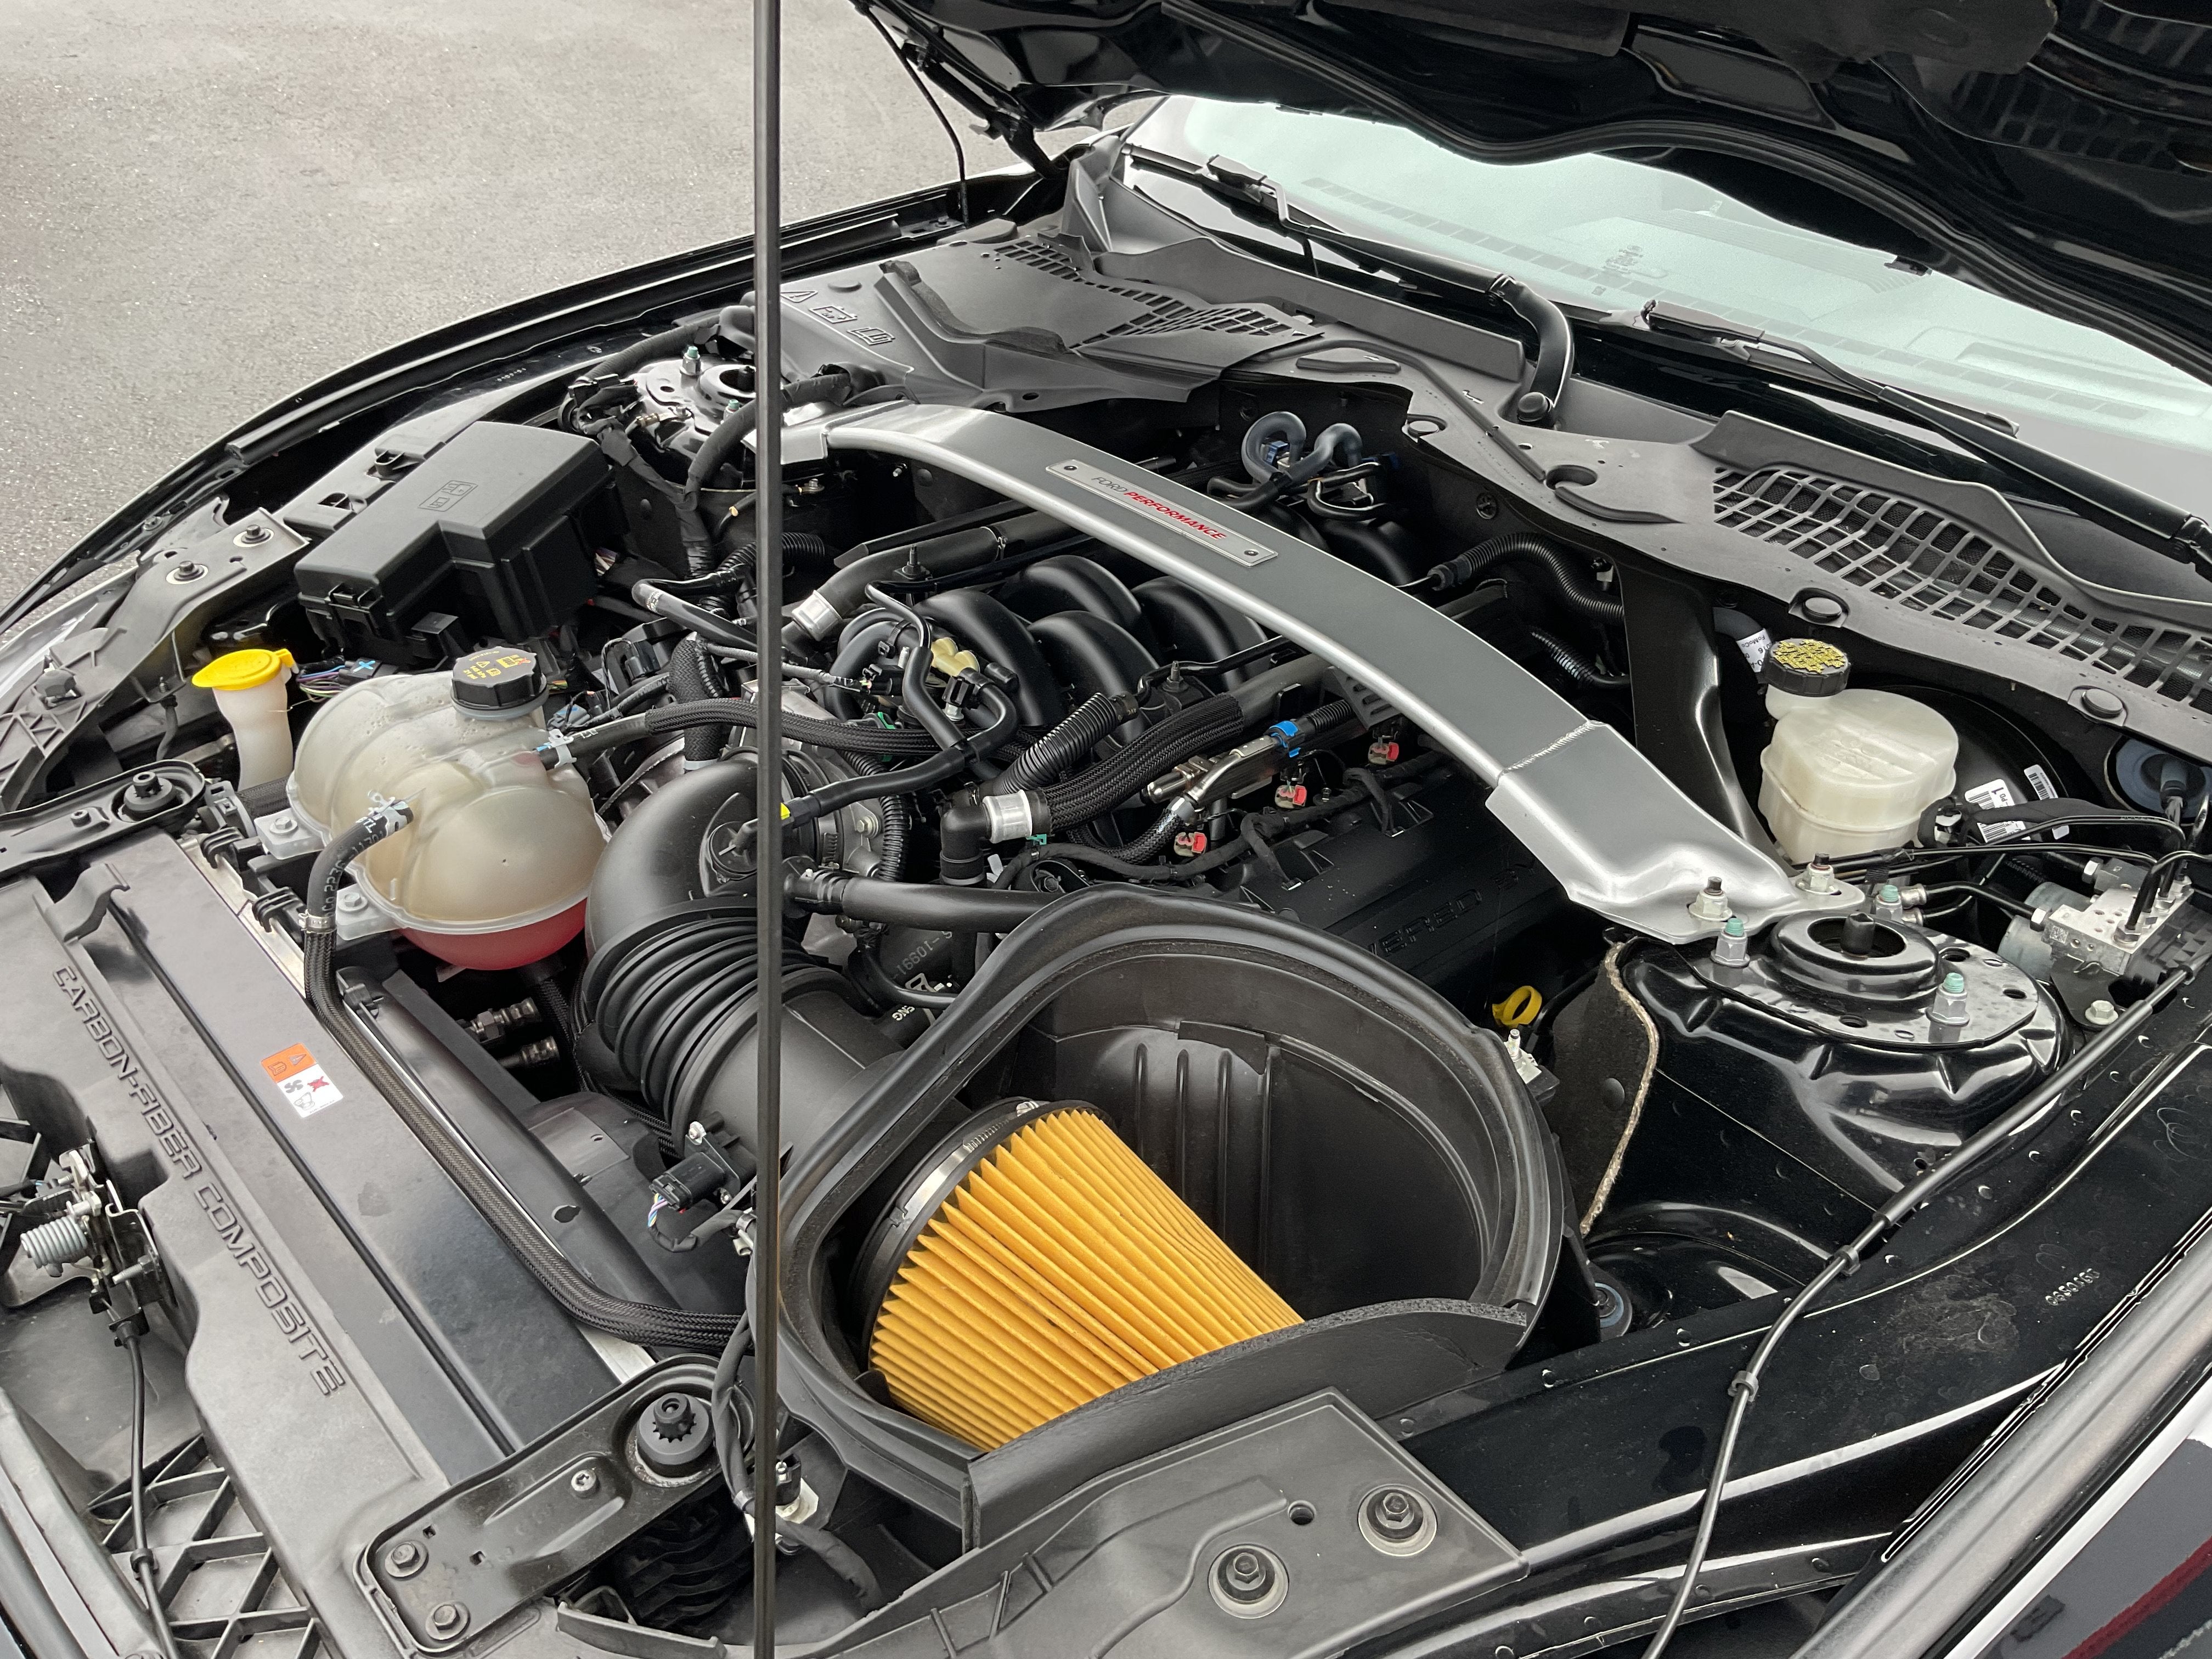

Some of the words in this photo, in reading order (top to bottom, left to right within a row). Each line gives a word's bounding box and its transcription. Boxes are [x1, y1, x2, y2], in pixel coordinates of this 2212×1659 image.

[1091, 476, 1128, 493] FORD
[1124, 492, 1227, 540] PERFORMANCE
[1369, 888, 1482, 956] ERED
[53, 966, 203, 1180] CARBON-FIBER
[194, 1183, 346, 1396] COMPOSITE
